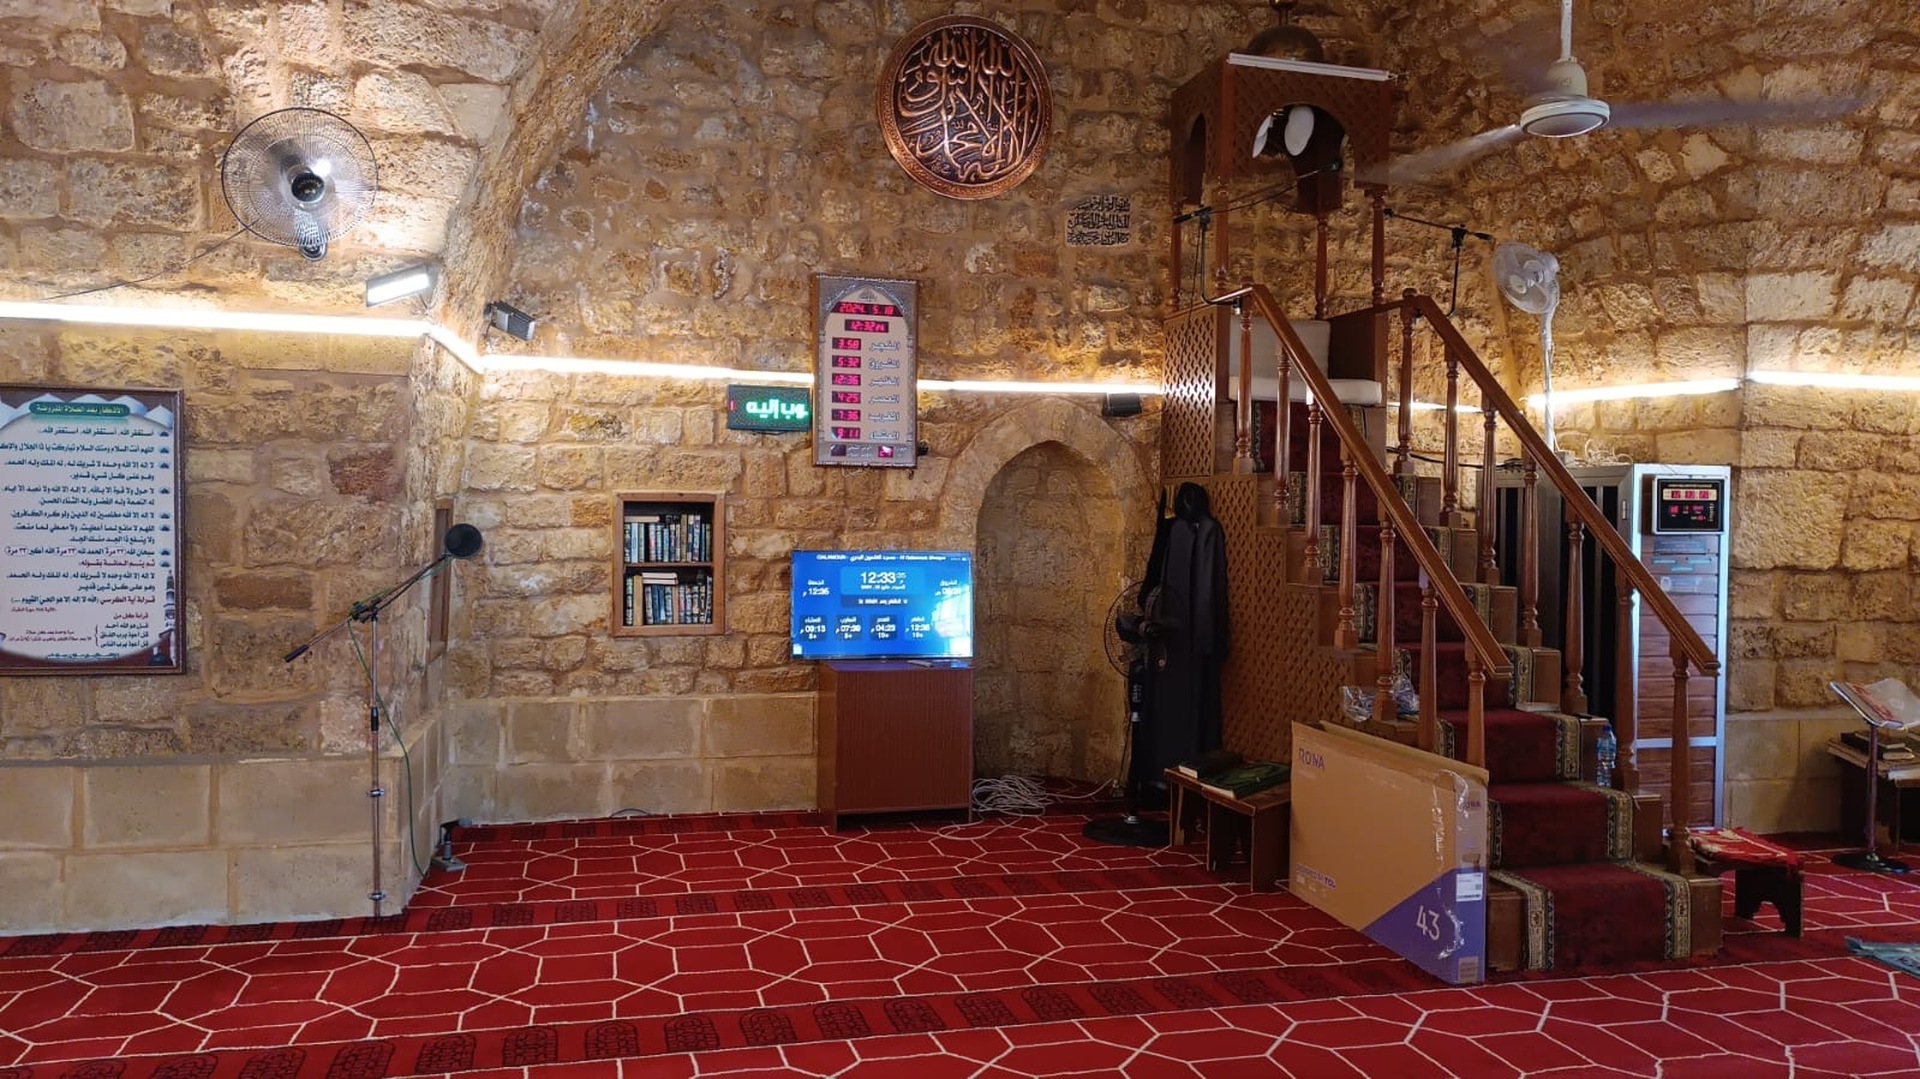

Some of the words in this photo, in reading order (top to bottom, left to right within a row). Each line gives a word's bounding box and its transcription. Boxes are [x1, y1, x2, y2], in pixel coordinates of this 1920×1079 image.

[869, 395, 899, 404] العصر
[861, 571, 897, 584] 12:33
[1416, 904, 1441, 941] 43
